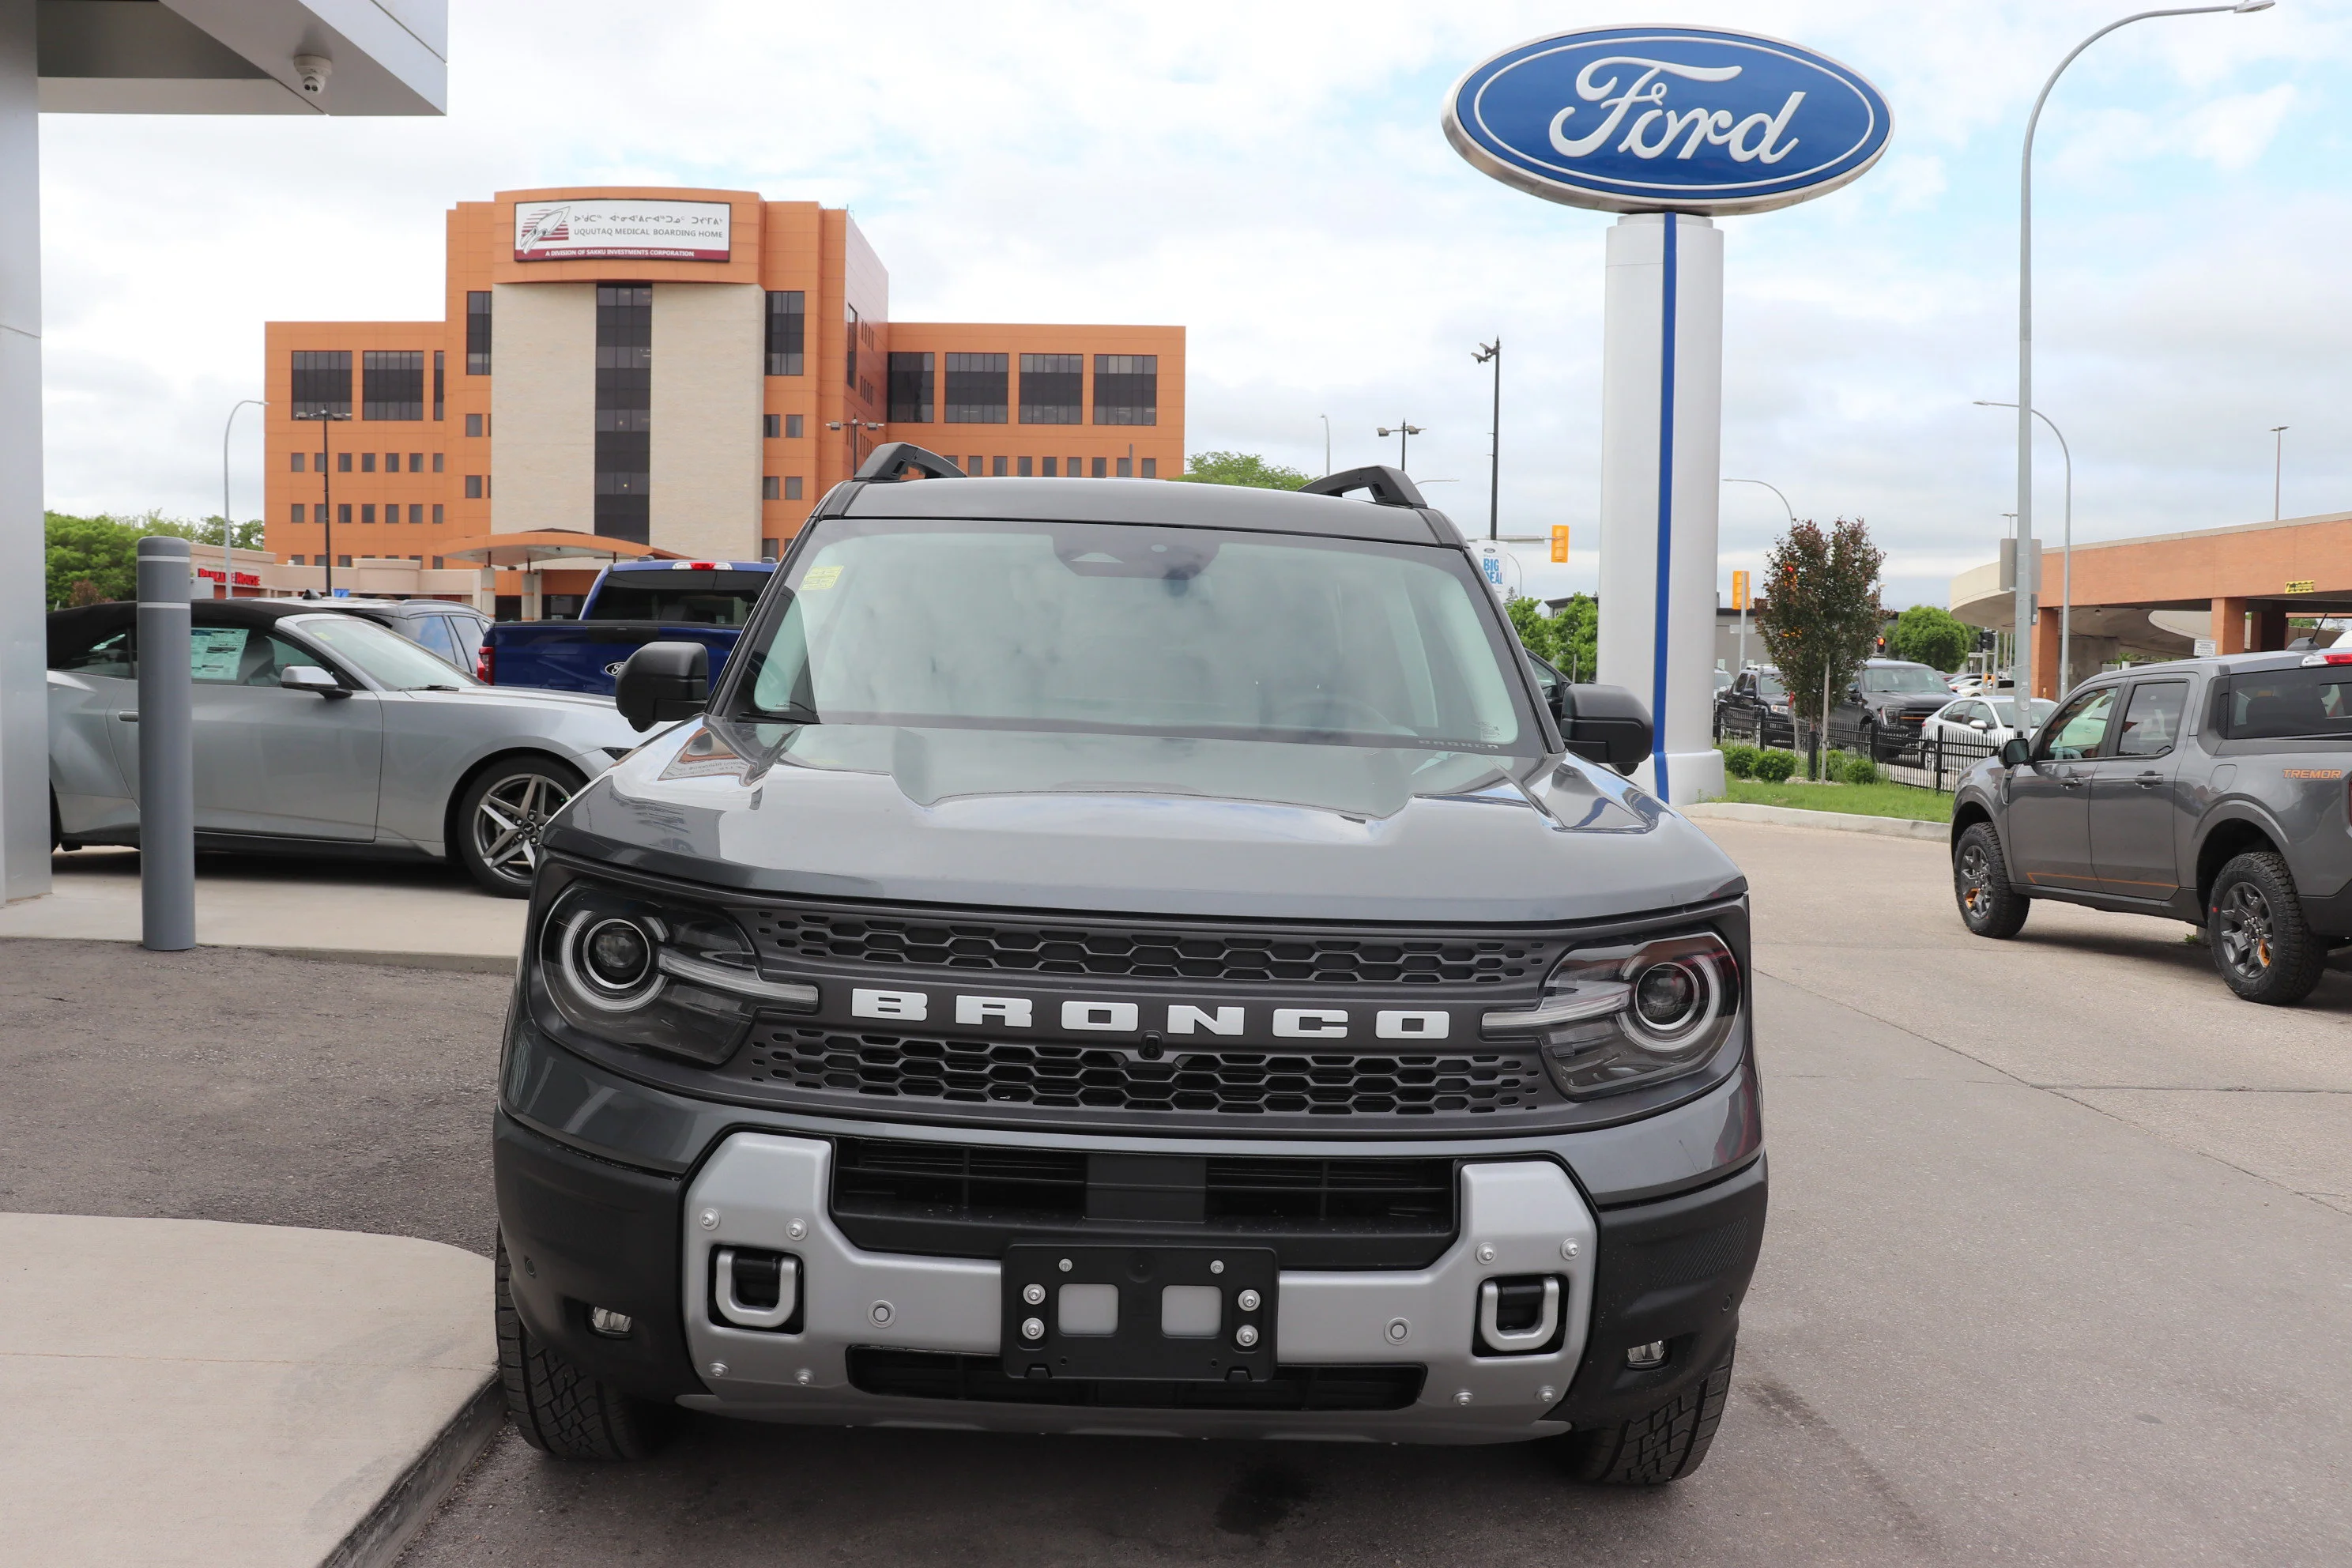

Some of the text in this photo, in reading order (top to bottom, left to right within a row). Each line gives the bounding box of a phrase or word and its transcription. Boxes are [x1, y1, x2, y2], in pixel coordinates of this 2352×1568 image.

[1549, 55, 1806, 164] Ford
[574, 228, 613, 236] UQUUTAQ
[1483, 558, 1499, 571] BIG
[2282, 769, 2343, 779] TREMOR
[851, 987, 1451, 1038] BRONCO
